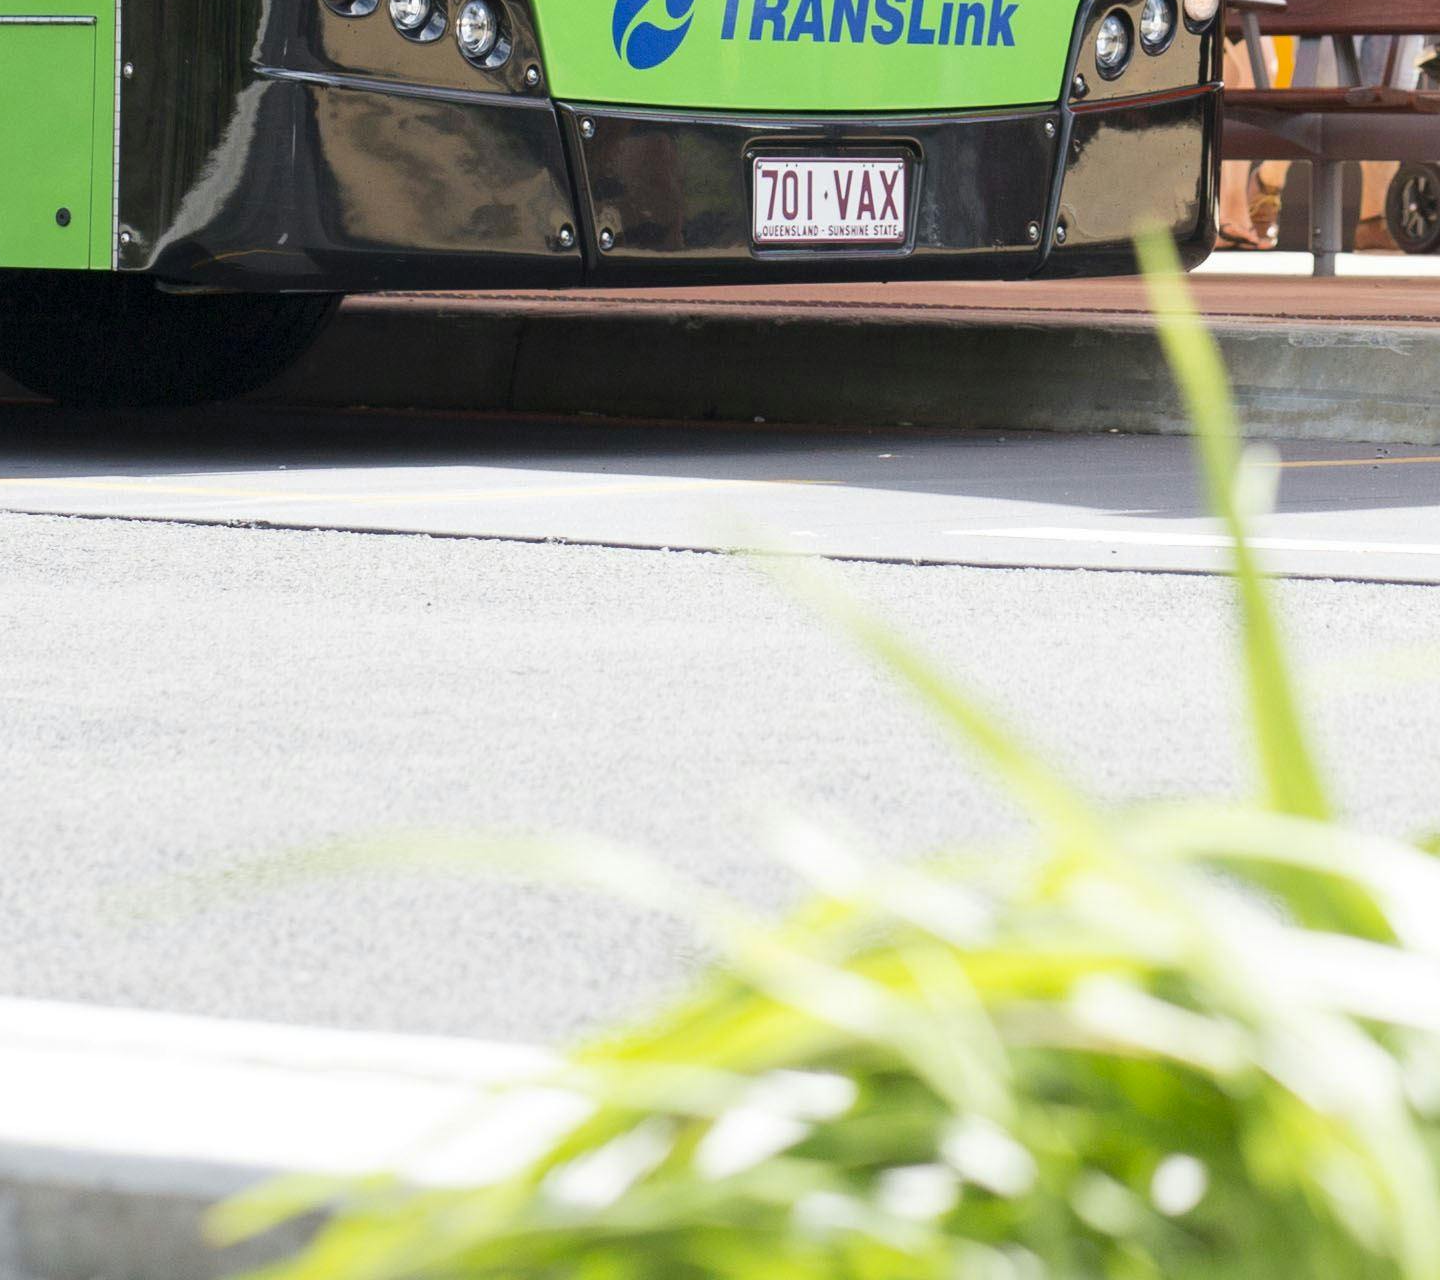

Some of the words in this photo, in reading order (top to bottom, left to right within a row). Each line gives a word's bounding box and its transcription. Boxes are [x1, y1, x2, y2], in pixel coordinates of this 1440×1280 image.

[762, 225, 819, 237] QUEENSLAND
[828, 225, 869, 237] SUNSHINE
[873, 225, 897, 236] STATE
